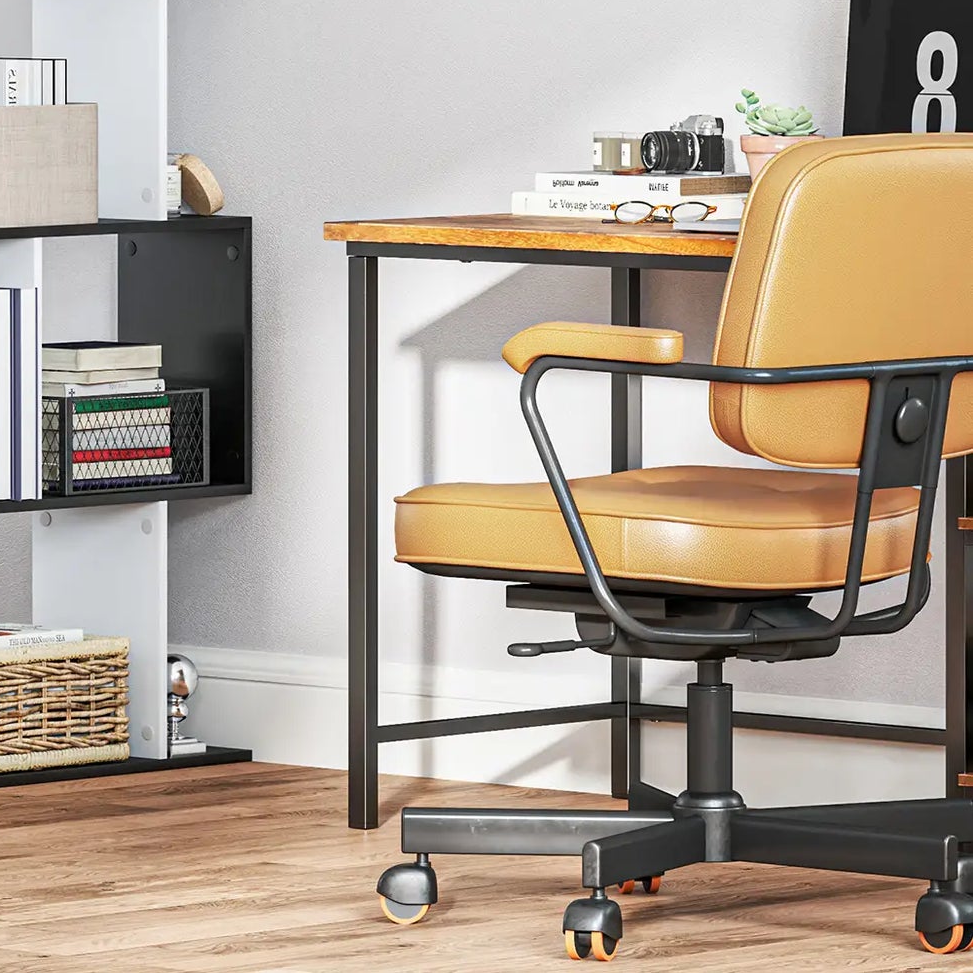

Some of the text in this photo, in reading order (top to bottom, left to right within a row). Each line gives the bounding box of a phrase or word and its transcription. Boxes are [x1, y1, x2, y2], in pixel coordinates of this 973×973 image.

[549, 199, 558, 209] Le
[560, 199, 587, 212] Voyage
[55, 634, 66, 642] SEA
